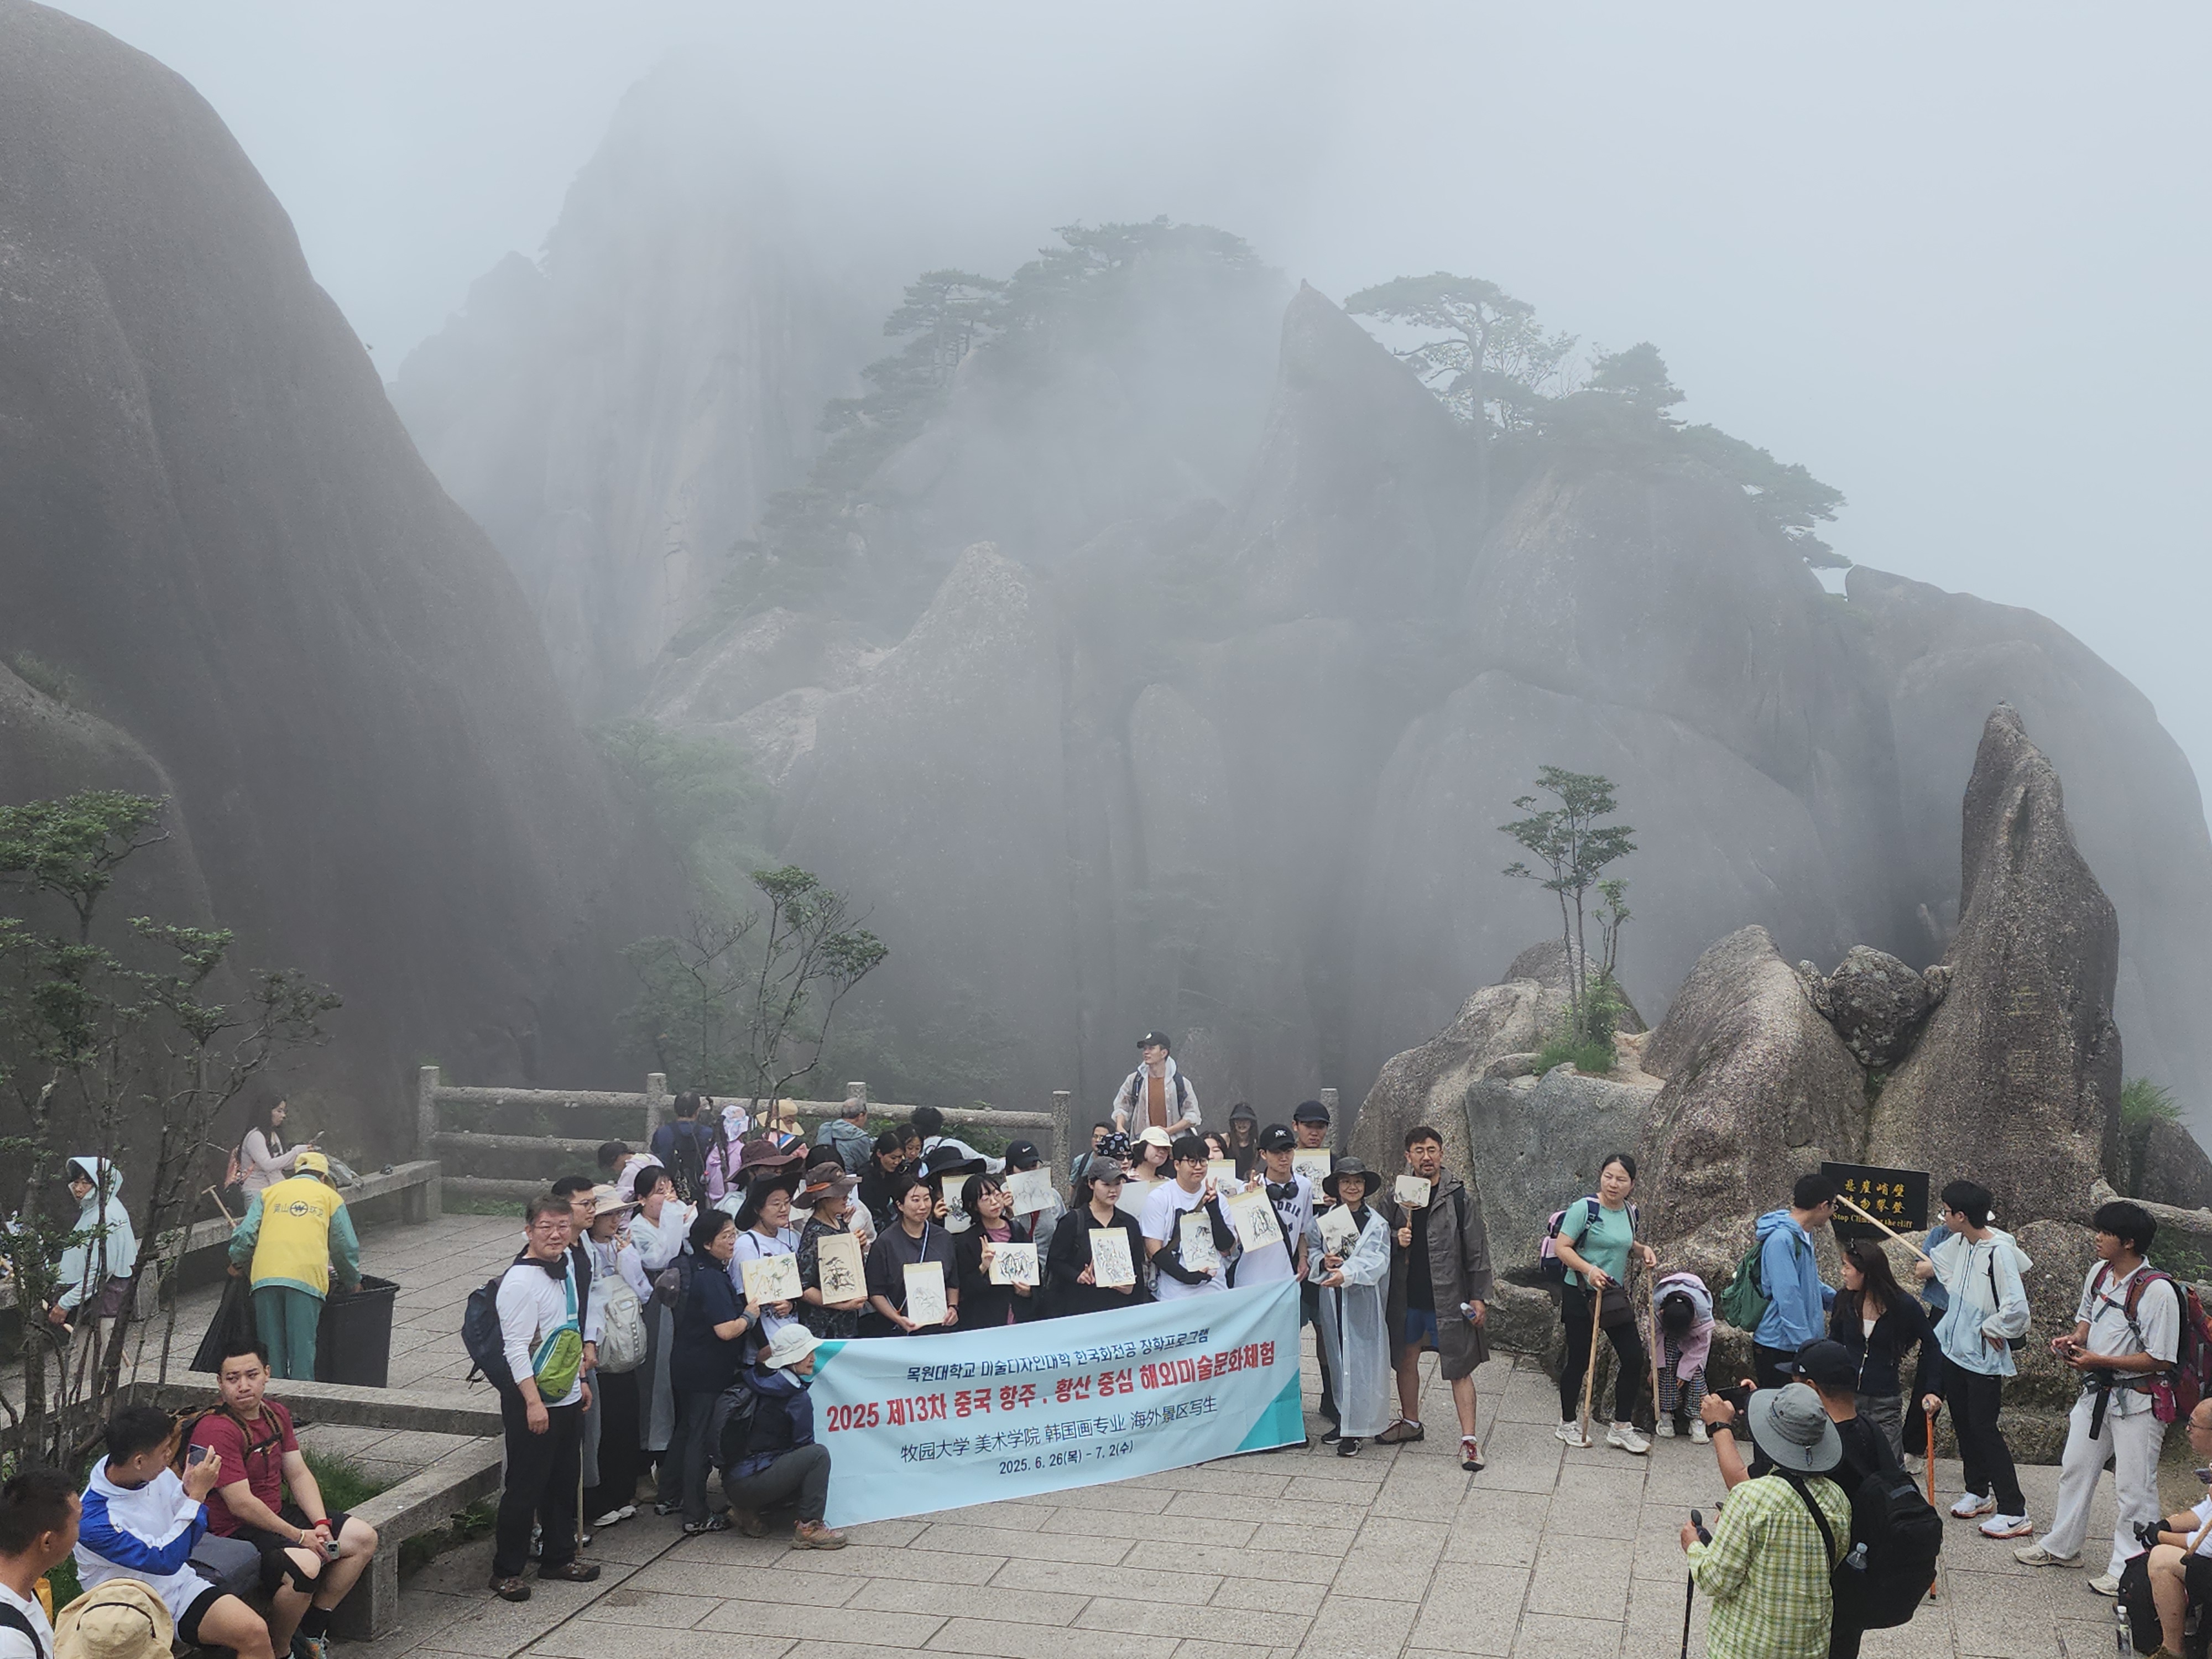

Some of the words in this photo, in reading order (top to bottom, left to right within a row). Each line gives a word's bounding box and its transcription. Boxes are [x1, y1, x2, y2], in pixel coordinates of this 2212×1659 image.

[1832, 1212, 1849, 1223] Stop
[1885, 1218, 1896, 1227] the
[907, 1362, 975, 1383] 목원대학교
[981, 1352, 1071, 1377] 미술디자인대학
[1073, 1342, 1137, 1365] 한국화전공
[1139, 1327, 1210, 1355] 장학프로그램
[827, 1402, 879, 1432] 2025
[886, 1392, 947, 1426] 제13차
[954, 1387, 992, 1418] 중국
[1055, 1374, 1092, 1403] 황산
[1098, 1368, 1134, 1397] 중심
[1139, 1340, 1275, 1390] 해외미술문화체험
[900, 1437, 971, 1463] 牧园大学
[975, 1427, 1041, 1454] 美术学院
[1044, 1414, 1126, 1443] 韩国画专业
[1130, 1395, 1218, 1430] 海外景区写生
[999, 1458, 1031, 1474] 2025.
[1049, 1449, 1082, 1468] 26(목)
[1109, 1440, 1134, 1457] 2(수)
